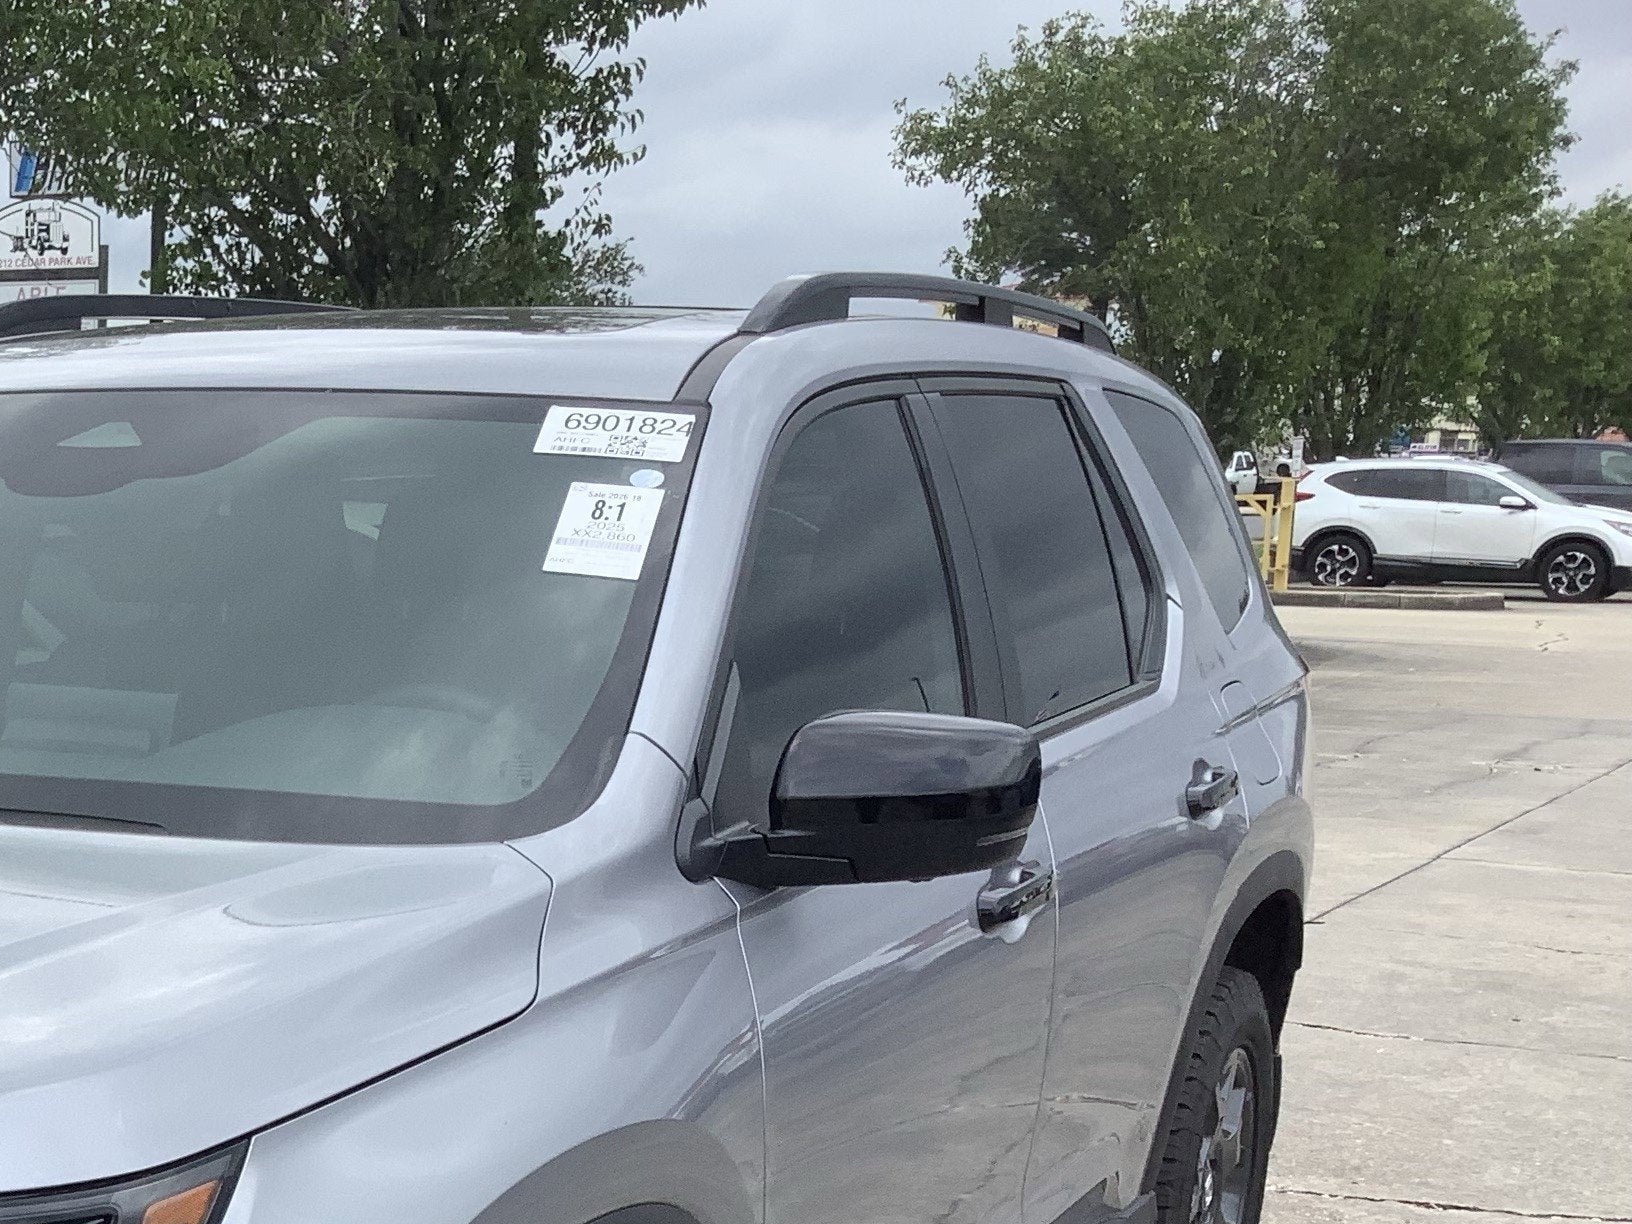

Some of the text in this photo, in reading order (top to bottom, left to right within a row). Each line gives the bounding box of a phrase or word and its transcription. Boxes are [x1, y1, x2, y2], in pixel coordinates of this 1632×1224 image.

[15, 258, 46, 268] CEDAR
[48, 257, 72, 267] PARK
[564, 412, 694, 437] 6901824
[588, 491, 606, 499] Sale
[591, 499, 626, 522] 8:1
